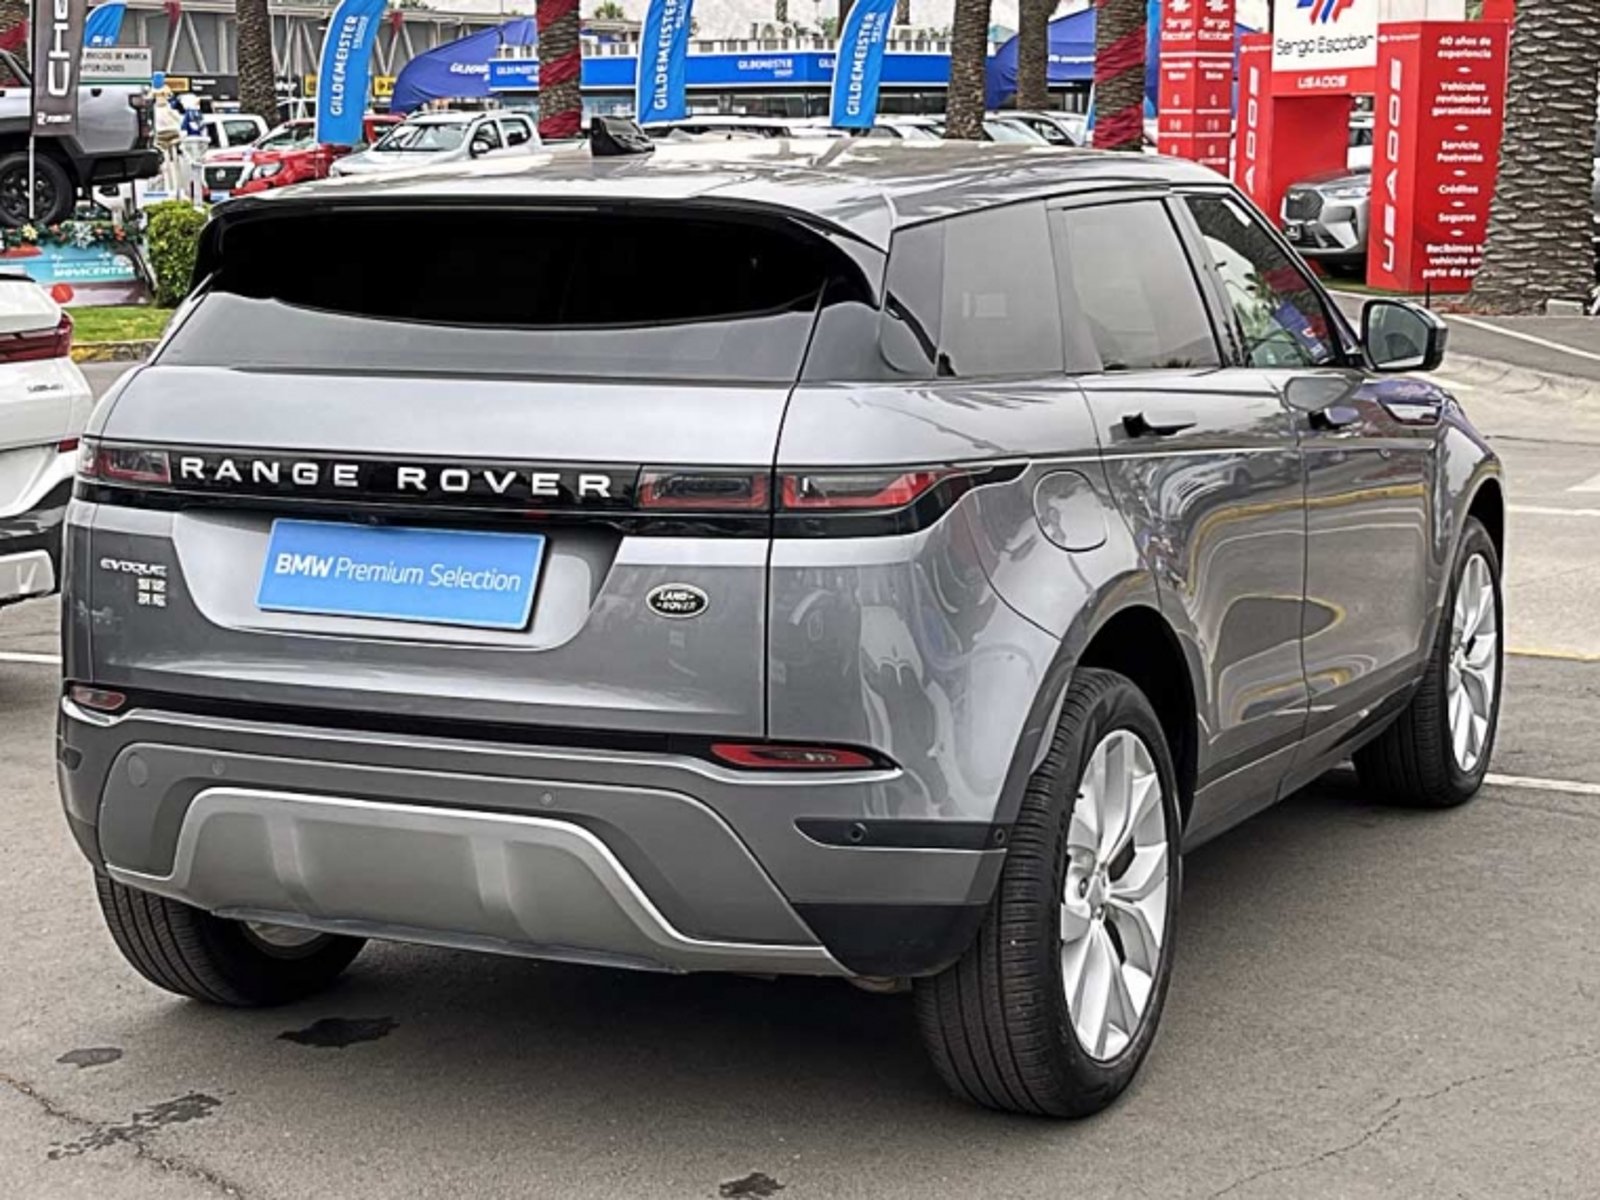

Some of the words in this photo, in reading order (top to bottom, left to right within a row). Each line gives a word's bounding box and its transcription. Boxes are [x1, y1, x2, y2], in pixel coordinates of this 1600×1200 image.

[1479, 36, 1492, 47] de
[330, 15, 359, 116] GILDEMEISTER
[846, 12, 877, 115] GILDEMEISTER
[1297, 75, 1348, 89] USADOS
[1442, 141, 1479, 150] Servicio
[1382, 57, 1402, 272] USADOS
[1438, 212, 1477, 224] Seguros
[1449, 267, 1462, 277] de
[179, 456, 360, 488] RANGE
[397, 466, 612, 499] ROVER
[100, 558, 167, 577] EVOQUE
[274, 552, 335, 578] BMW
[334, 556, 424, 586] Premium
[427, 562, 522, 592] Selection
